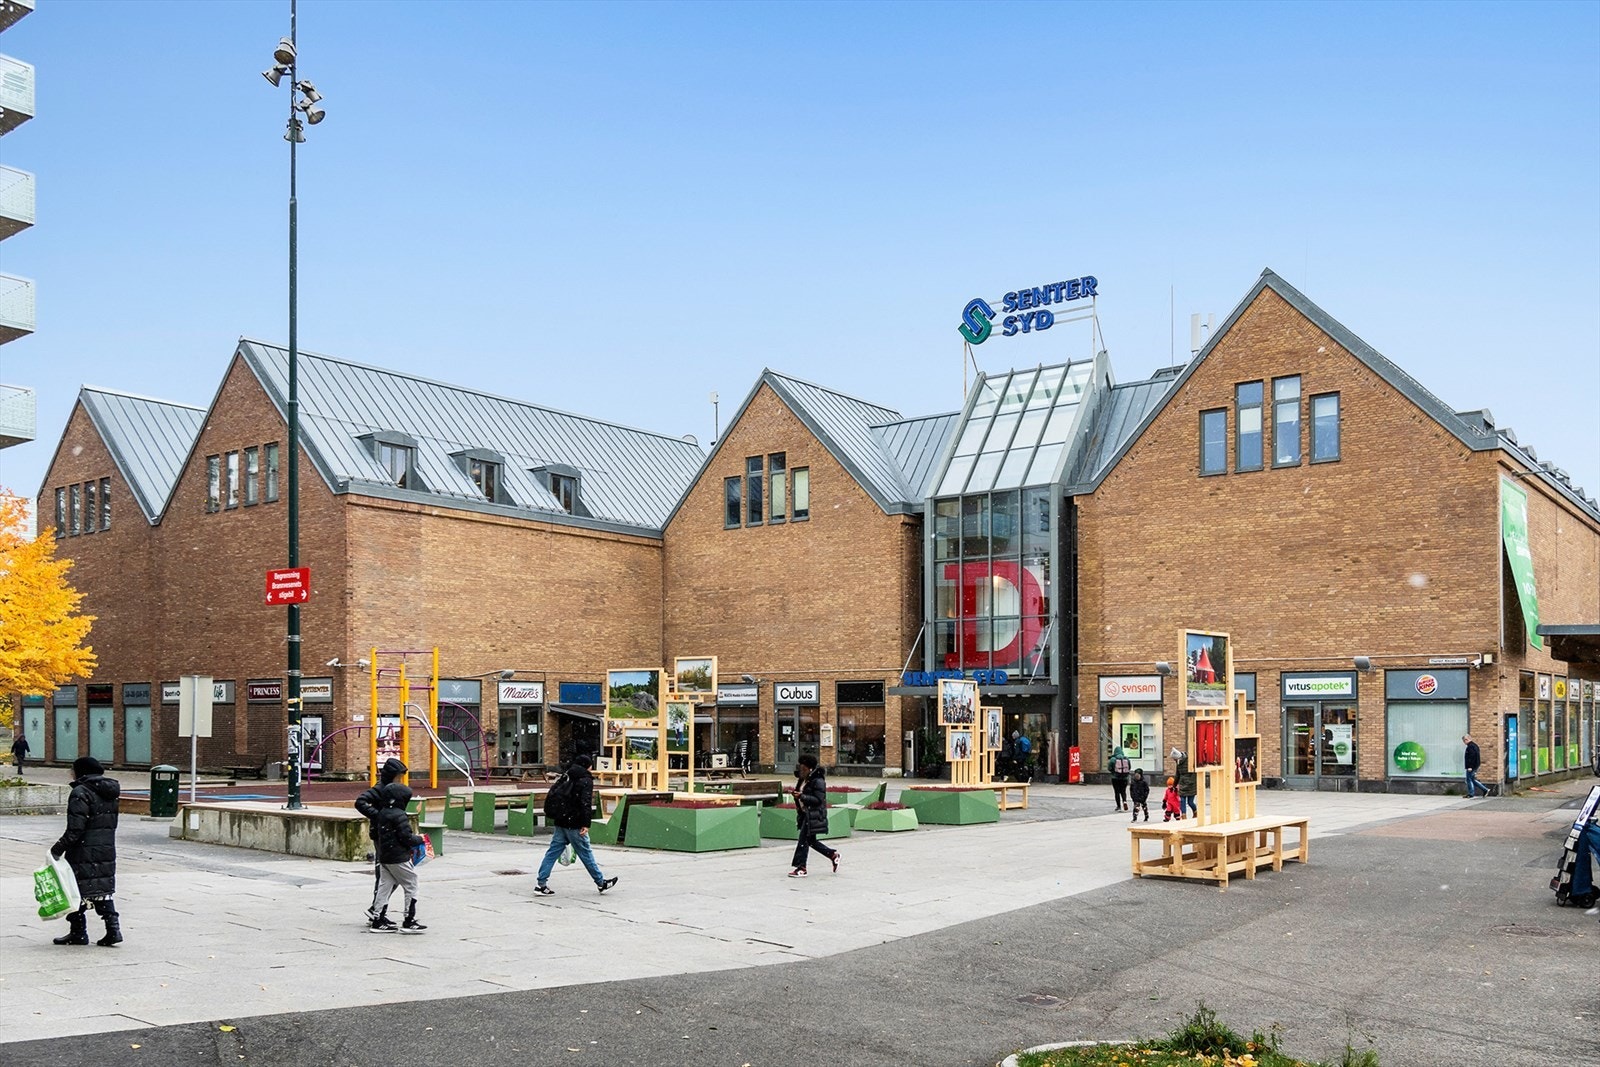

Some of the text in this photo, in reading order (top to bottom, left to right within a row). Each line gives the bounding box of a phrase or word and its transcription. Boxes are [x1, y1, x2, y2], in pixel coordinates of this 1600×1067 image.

[1002, 275, 1098, 313] SENTER
[1002, 309, 1054, 336] SYD
[903, 670, 1008, 686] SENTER SYD
[253, 687, 280, 696] PRINCESS
[1418, 681, 1435, 690] KING
[780, 687, 813, 700] Cubus
